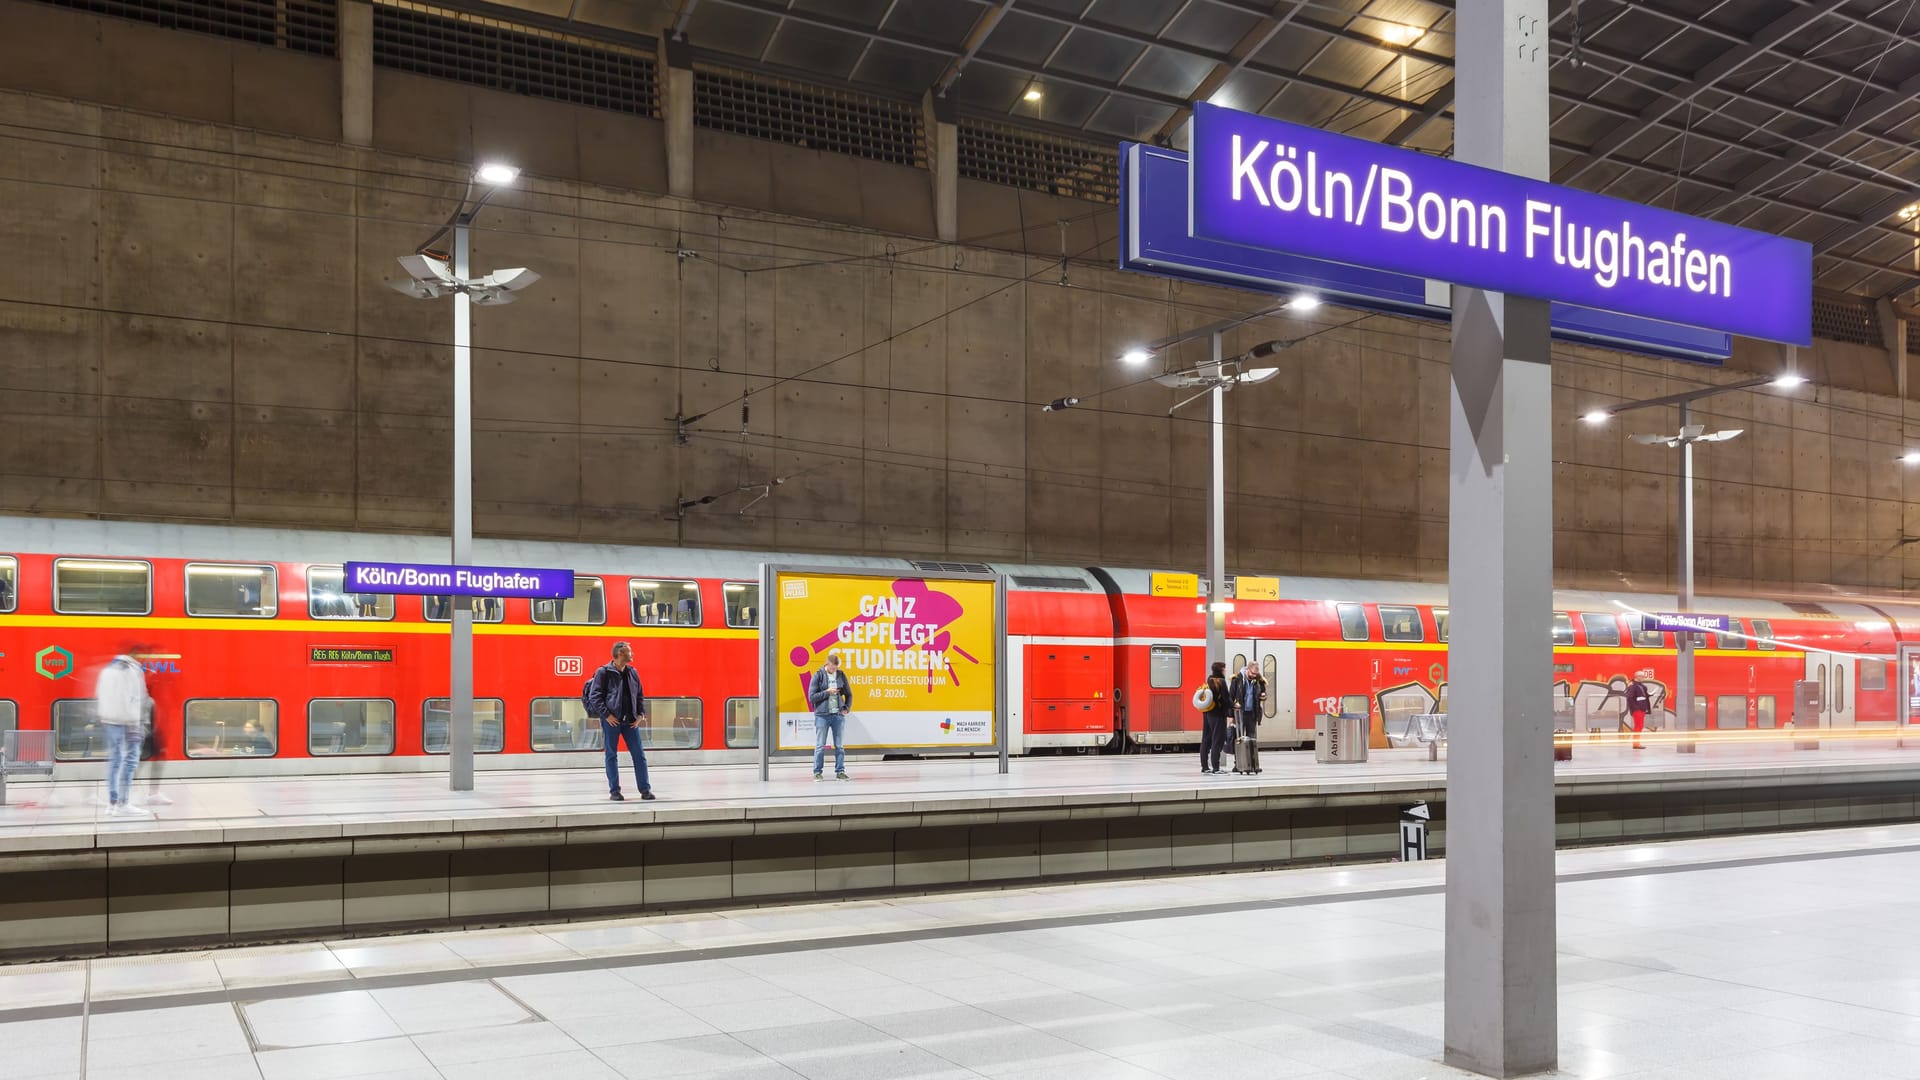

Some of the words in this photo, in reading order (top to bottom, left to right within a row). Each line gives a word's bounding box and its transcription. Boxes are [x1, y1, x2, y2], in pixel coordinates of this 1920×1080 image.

[1229, 134, 1508, 253] Köln/Bonn
[1524, 200, 1732, 297] Flughafen
[356, 567, 451, 587] Köln/Bonn
[455, 571, 540, 591] Flughafen
[859, 594, 916, 619] GANZ
[1696, 616, 1721, 629] Airport
[837, 621, 938, 645] GEPFLEGT
[313, 649, 327, 660] RE6
[328, 650, 340, 660] RE6
[559, 660, 579, 672] DB
[1373, 660, 1379, 673] 1
[849, 675, 873, 685] NEUE
[875, 676, 946, 686] PFLEGESTUDIUM
[869, 689, 882, 697] AB
[884, 689, 907, 698] 2020.
[1330, 728, 1339, 757] Abfall
[1403, 826, 1422, 861] H
